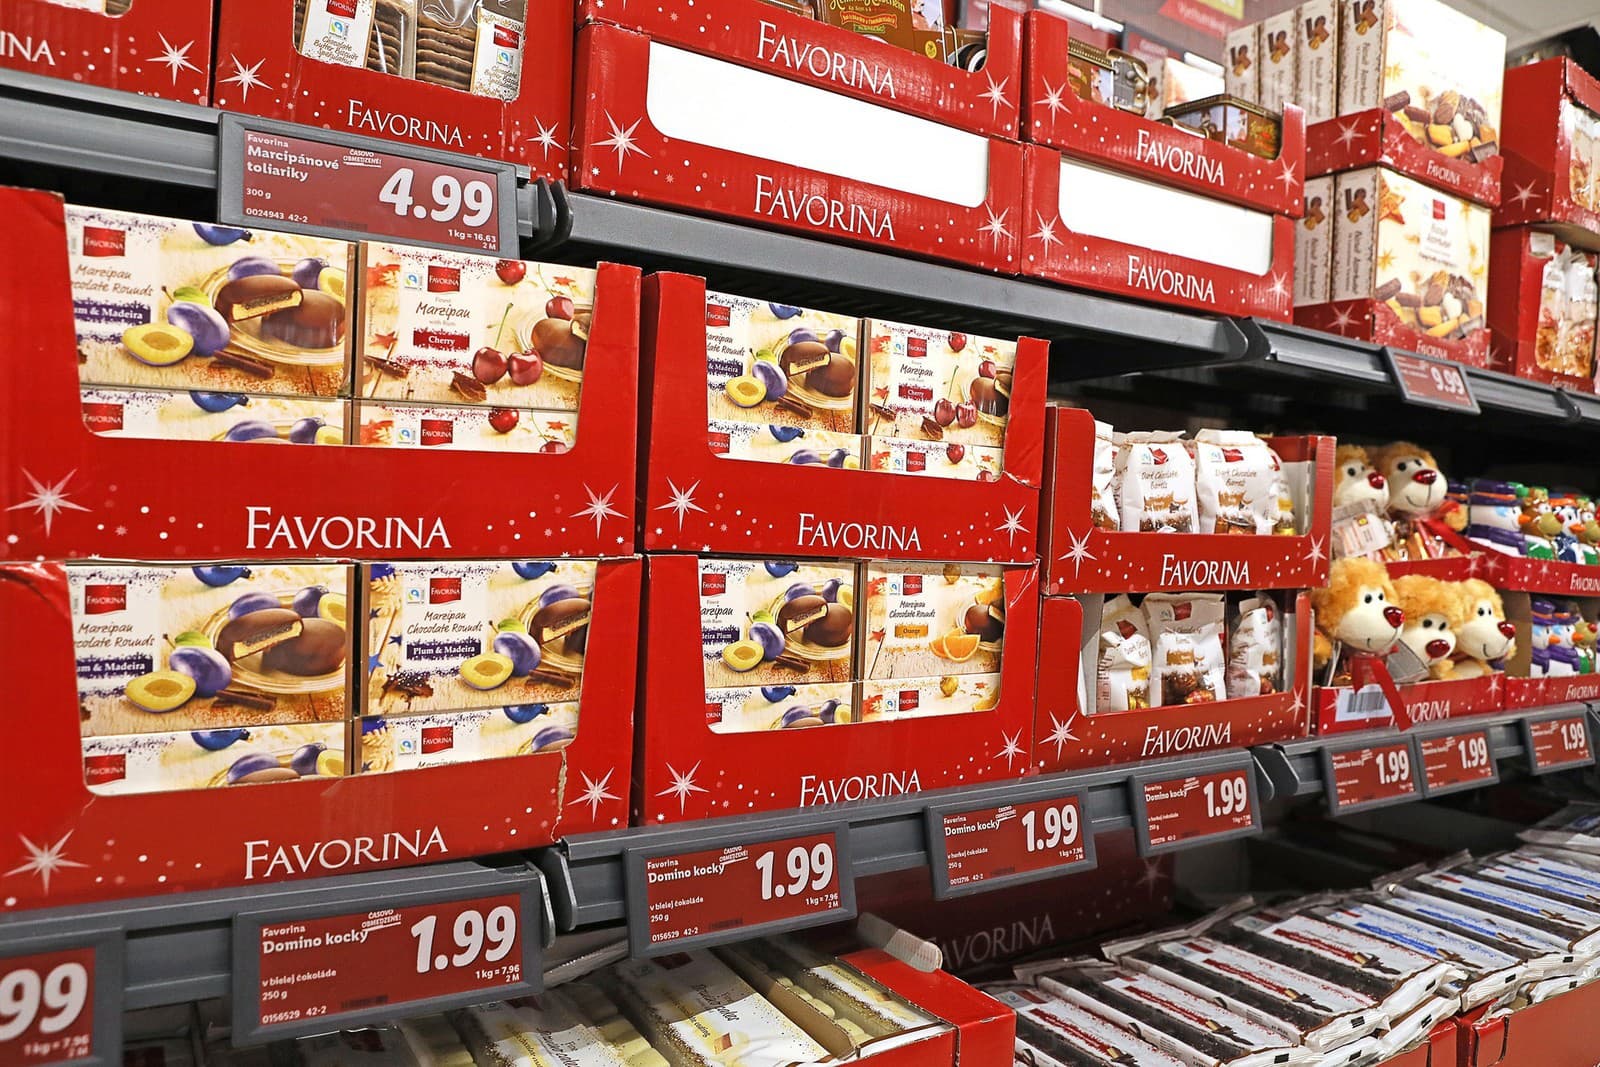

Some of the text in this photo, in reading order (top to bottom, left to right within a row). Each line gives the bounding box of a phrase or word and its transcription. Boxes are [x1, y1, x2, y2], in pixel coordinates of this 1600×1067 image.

[757, 20, 896, 99] FAVORINA
[346, 99, 464, 148] FAVORINA
[247, 133, 288, 148] Favorina
[247, 145, 340, 170] Marcipánové
[1136, 128, 1225, 187] FAVORINA
[247, 162, 308, 182] toliariky
[246, 187, 272, 200] 300 g
[379, 168, 493, 227] 4.99
[246, 207, 309, 223] 0024943 42-2
[754, 174, 896, 241] FAVORINA
[453, 229, 467, 241] kg
[474, 233, 497, 243] 16.63
[75, 264, 132, 281] Marzipan
[429, 275, 460, 286] FAVORINA
[1126, 254, 1215, 304] FAVORINA
[72, 279, 154, 297] colate Rounds
[101, 308, 144, 320] Madeira
[415, 300, 471, 319] Marzipan
[428, 335, 456, 346] Cherry
[707, 333, 734, 345] arzipan
[900, 364, 934, 378] Marzipan
[1430, 366, 1465, 395] 9.99
[245, 506, 452, 550] FAVORINA
[797, 512, 922, 551] FAVORINA
[1159, 553, 1251, 587] FAVORINA
[431, 586, 461, 597] FAVORINA
[424, 611, 467, 625] Marzipan
[701, 605, 734, 619] arzipan
[78, 621, 134, 636] Marzipan
[407, 621, 484, 635] Chocolate Rounds
[74, 634, 155, 648] colate Rounds
[413, 643, 475, 655] Plum & Madeira
[104, 661, 146, 671] Madeira
[422, 735, 453, 745] FAVORINA
[1141, 721, 1232, 757] FAVORINA
[1561, 722, 1586, 751] 1.99
[1458, 737, 1488, 769] 1.99
[1376, 749, 1410, 785] 1.99
[799, 769, 922, 808] FAVORINA
[1145, 792, 1169, 802] Domino
[1203, 777, 1247, 818] 1.99
[944, 816, 966, 825] Favorina
[945, 820, 1000, 836] Domino kocky
[1022, 804, 1078, 852] 1.99
[244, 826, 449, 881] FAVORINA
[647, 858, 679, 870] Favorina
[756, 842, 833, 900] 1.99
[648, 862, 725, 884] Domino kocky
[655, 899, 675, 911] bielej
[675, 896, 704, 908] čokoláde
[809, 896, 819, 906] kg
[825, 893, 839, 902] 7.96
[368, 908, 394, 920] ČASOVO
[651, 913, 664, 923] 250
[262, 924, 306, 938] Favorina
[411, 905, 516, 973] 1.99
[652, 926, 699, 942] 0156529 42-2
[262, 928, 369, 954] Domino kocky
[928, 913, 1056, 969] AVORINA
[269, 973, 295, 988] bielej
[296, 968, 337, 982] čokoláde
[480, 969, 494, 980] kg
[501, 964, 520, 975] 7.96
[512, 973, 520, 981] M
[262, 990, 288, 1001] 250 g
[262, 1005, 327, 1024] 0156529 42-2
